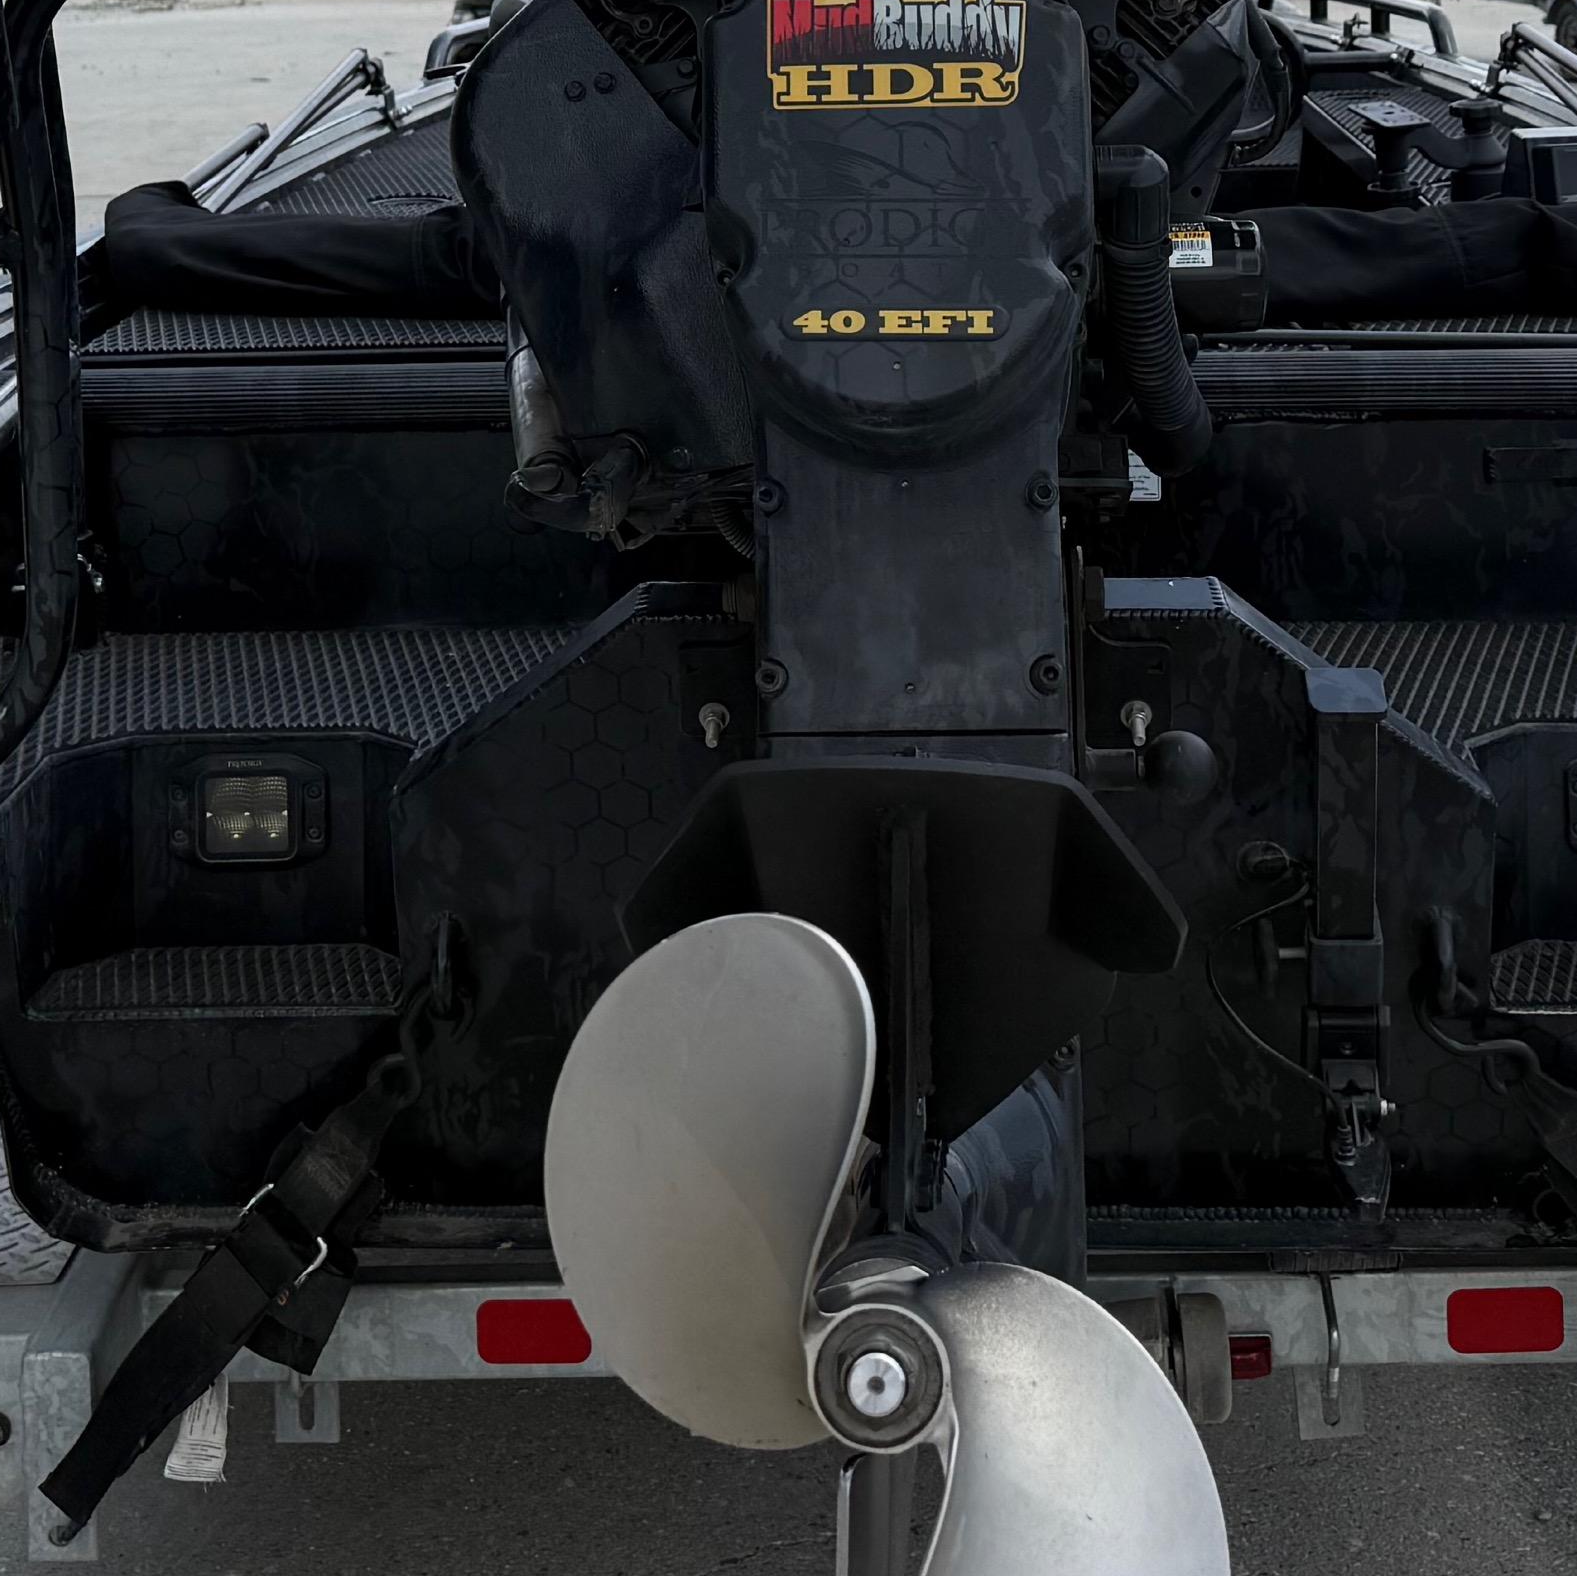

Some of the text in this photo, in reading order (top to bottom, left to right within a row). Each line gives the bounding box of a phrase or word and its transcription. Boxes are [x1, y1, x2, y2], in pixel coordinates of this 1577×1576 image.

[777, 62, 1015, 103] HDR
[793, 310, 994, 334] 40 EFI
